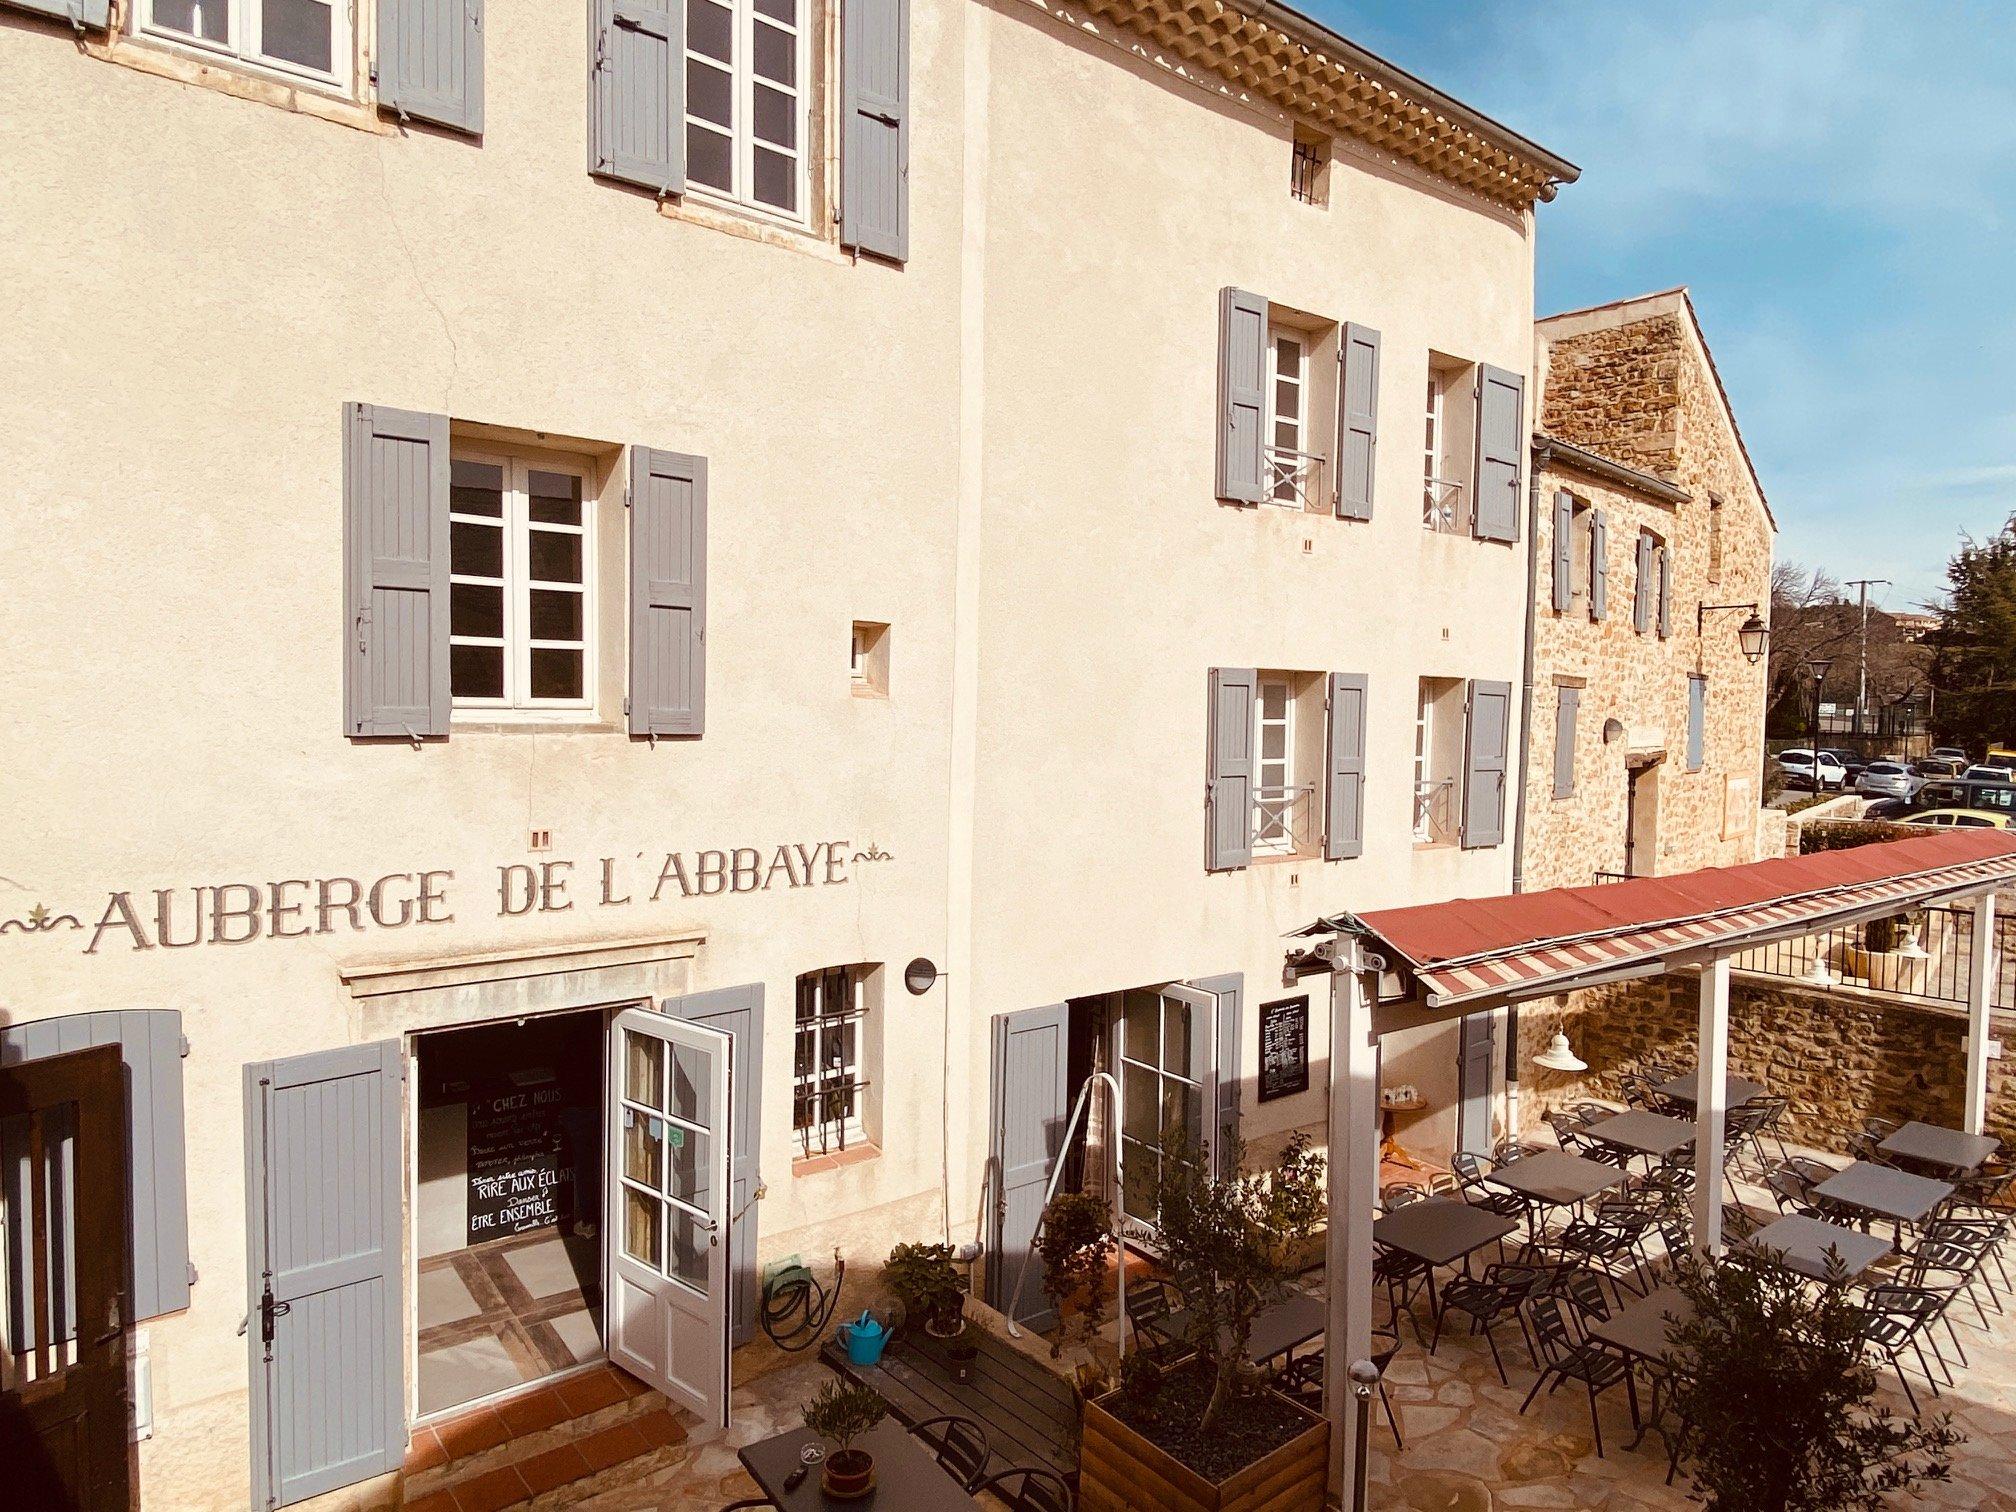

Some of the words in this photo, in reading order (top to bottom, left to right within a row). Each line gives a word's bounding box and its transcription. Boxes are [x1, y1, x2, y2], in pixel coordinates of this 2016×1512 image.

[82, 869, 456, 954] AUBERGE
[497, 861, 574, 918] DE
[493, 1094, 528, 1112] CHEZ
[533, 1088, 562, 1106] NOUS
[477, 1180, 507, 1200] RIRE
[511, 1175, 535, 1194] AUX
[471, 1212, 497, 1231] ÊTRE
[500, 1198, 556, 1225] ENSEMBLE
